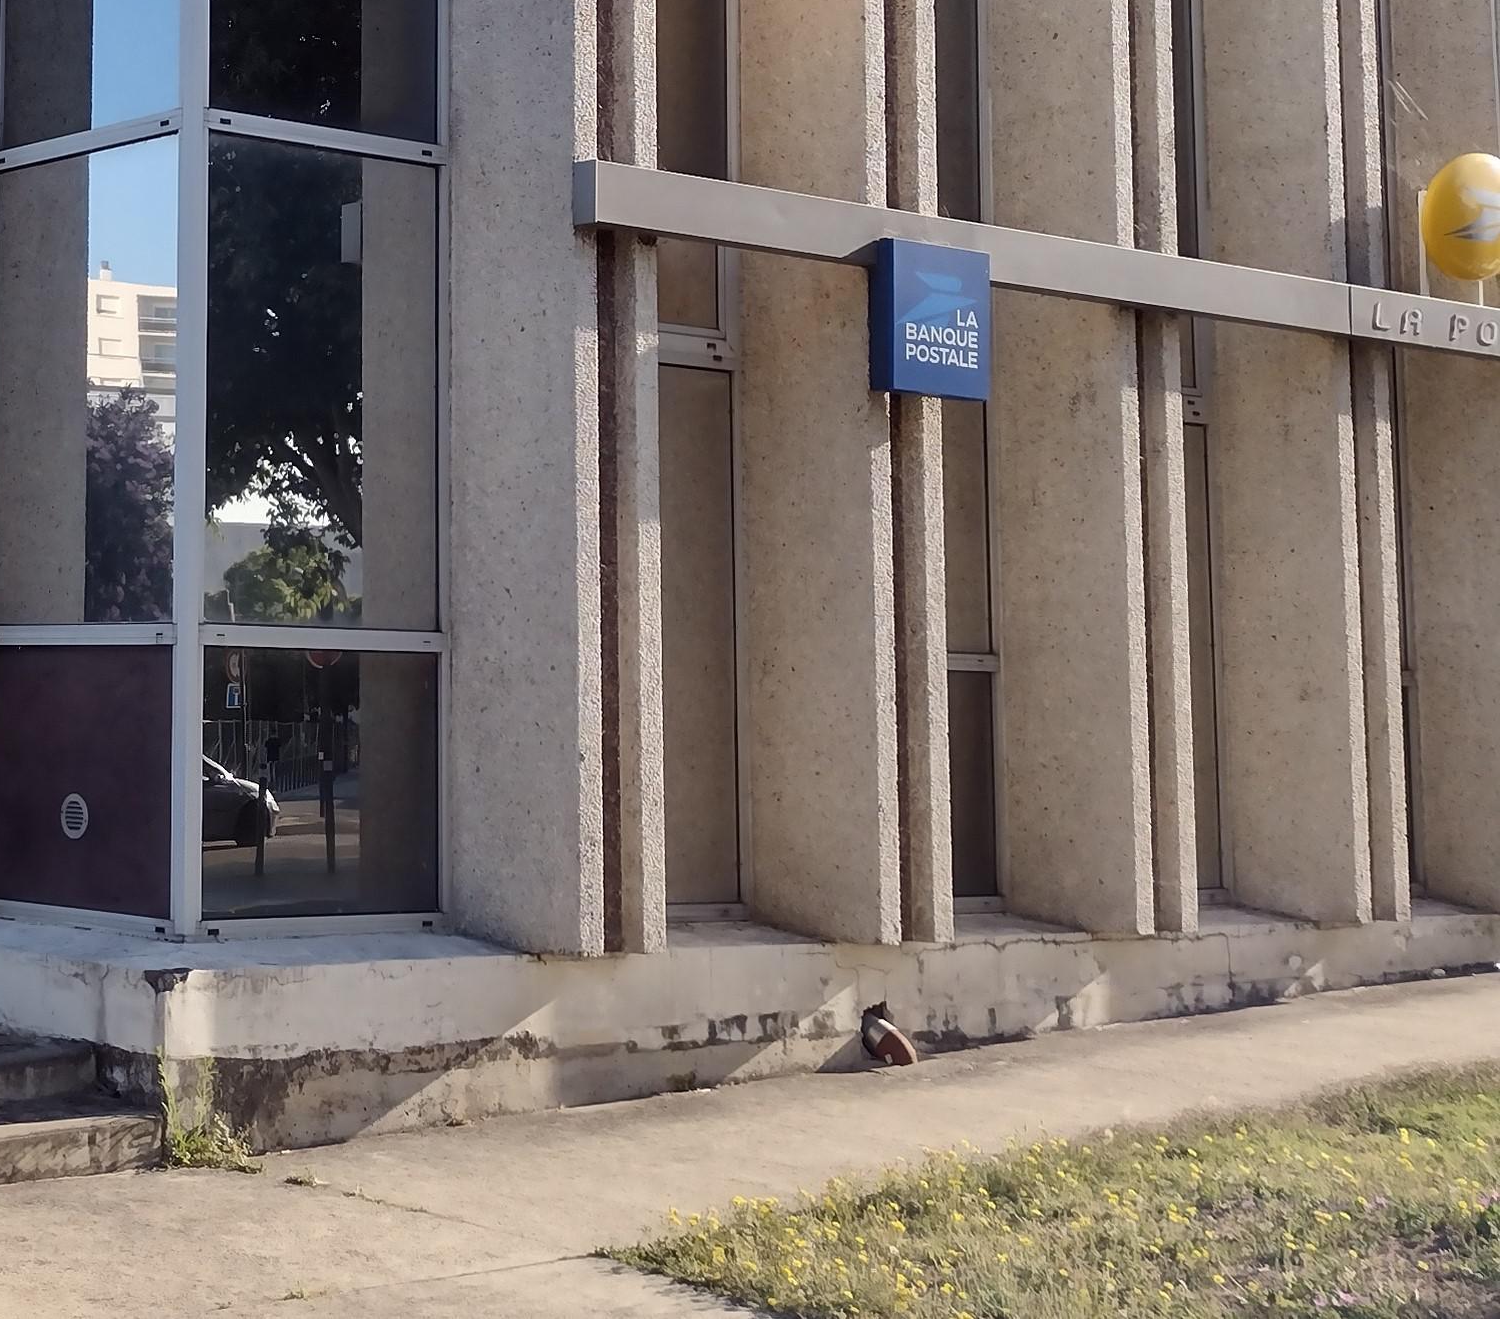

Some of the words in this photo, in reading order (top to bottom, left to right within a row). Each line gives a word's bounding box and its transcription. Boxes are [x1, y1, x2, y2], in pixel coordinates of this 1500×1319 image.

[956, 309, 979, 329] LA
[1372, 301, 1423, 337] LA
[1449, 313, 1498, 347] PO
[905, 322, 979, 349] BANQUE
[905, 343, 979, 369] POSTALE
